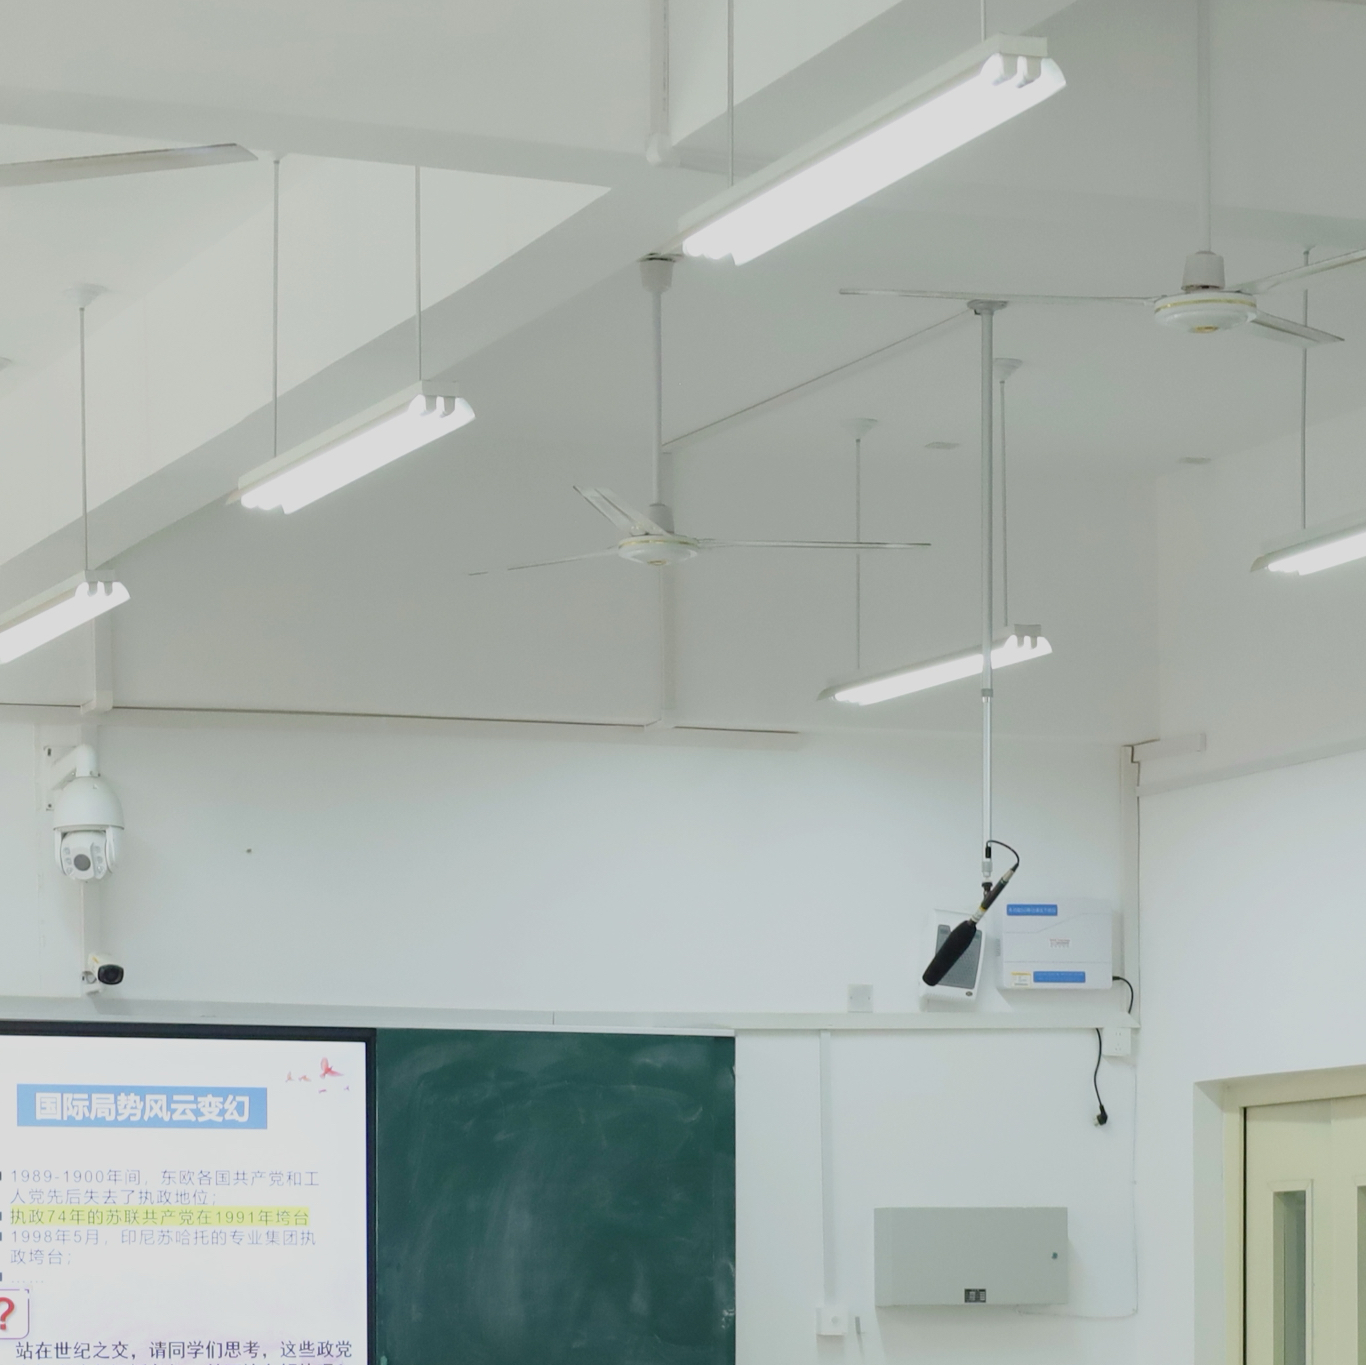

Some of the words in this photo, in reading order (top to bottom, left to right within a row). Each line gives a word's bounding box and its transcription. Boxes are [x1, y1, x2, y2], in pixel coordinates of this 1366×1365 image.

[36, 1092, 250, 1122] 国际局势风云变幻
[10, 1209, 310, 1226] 执政74年的苏联共产党在1991年垮台
